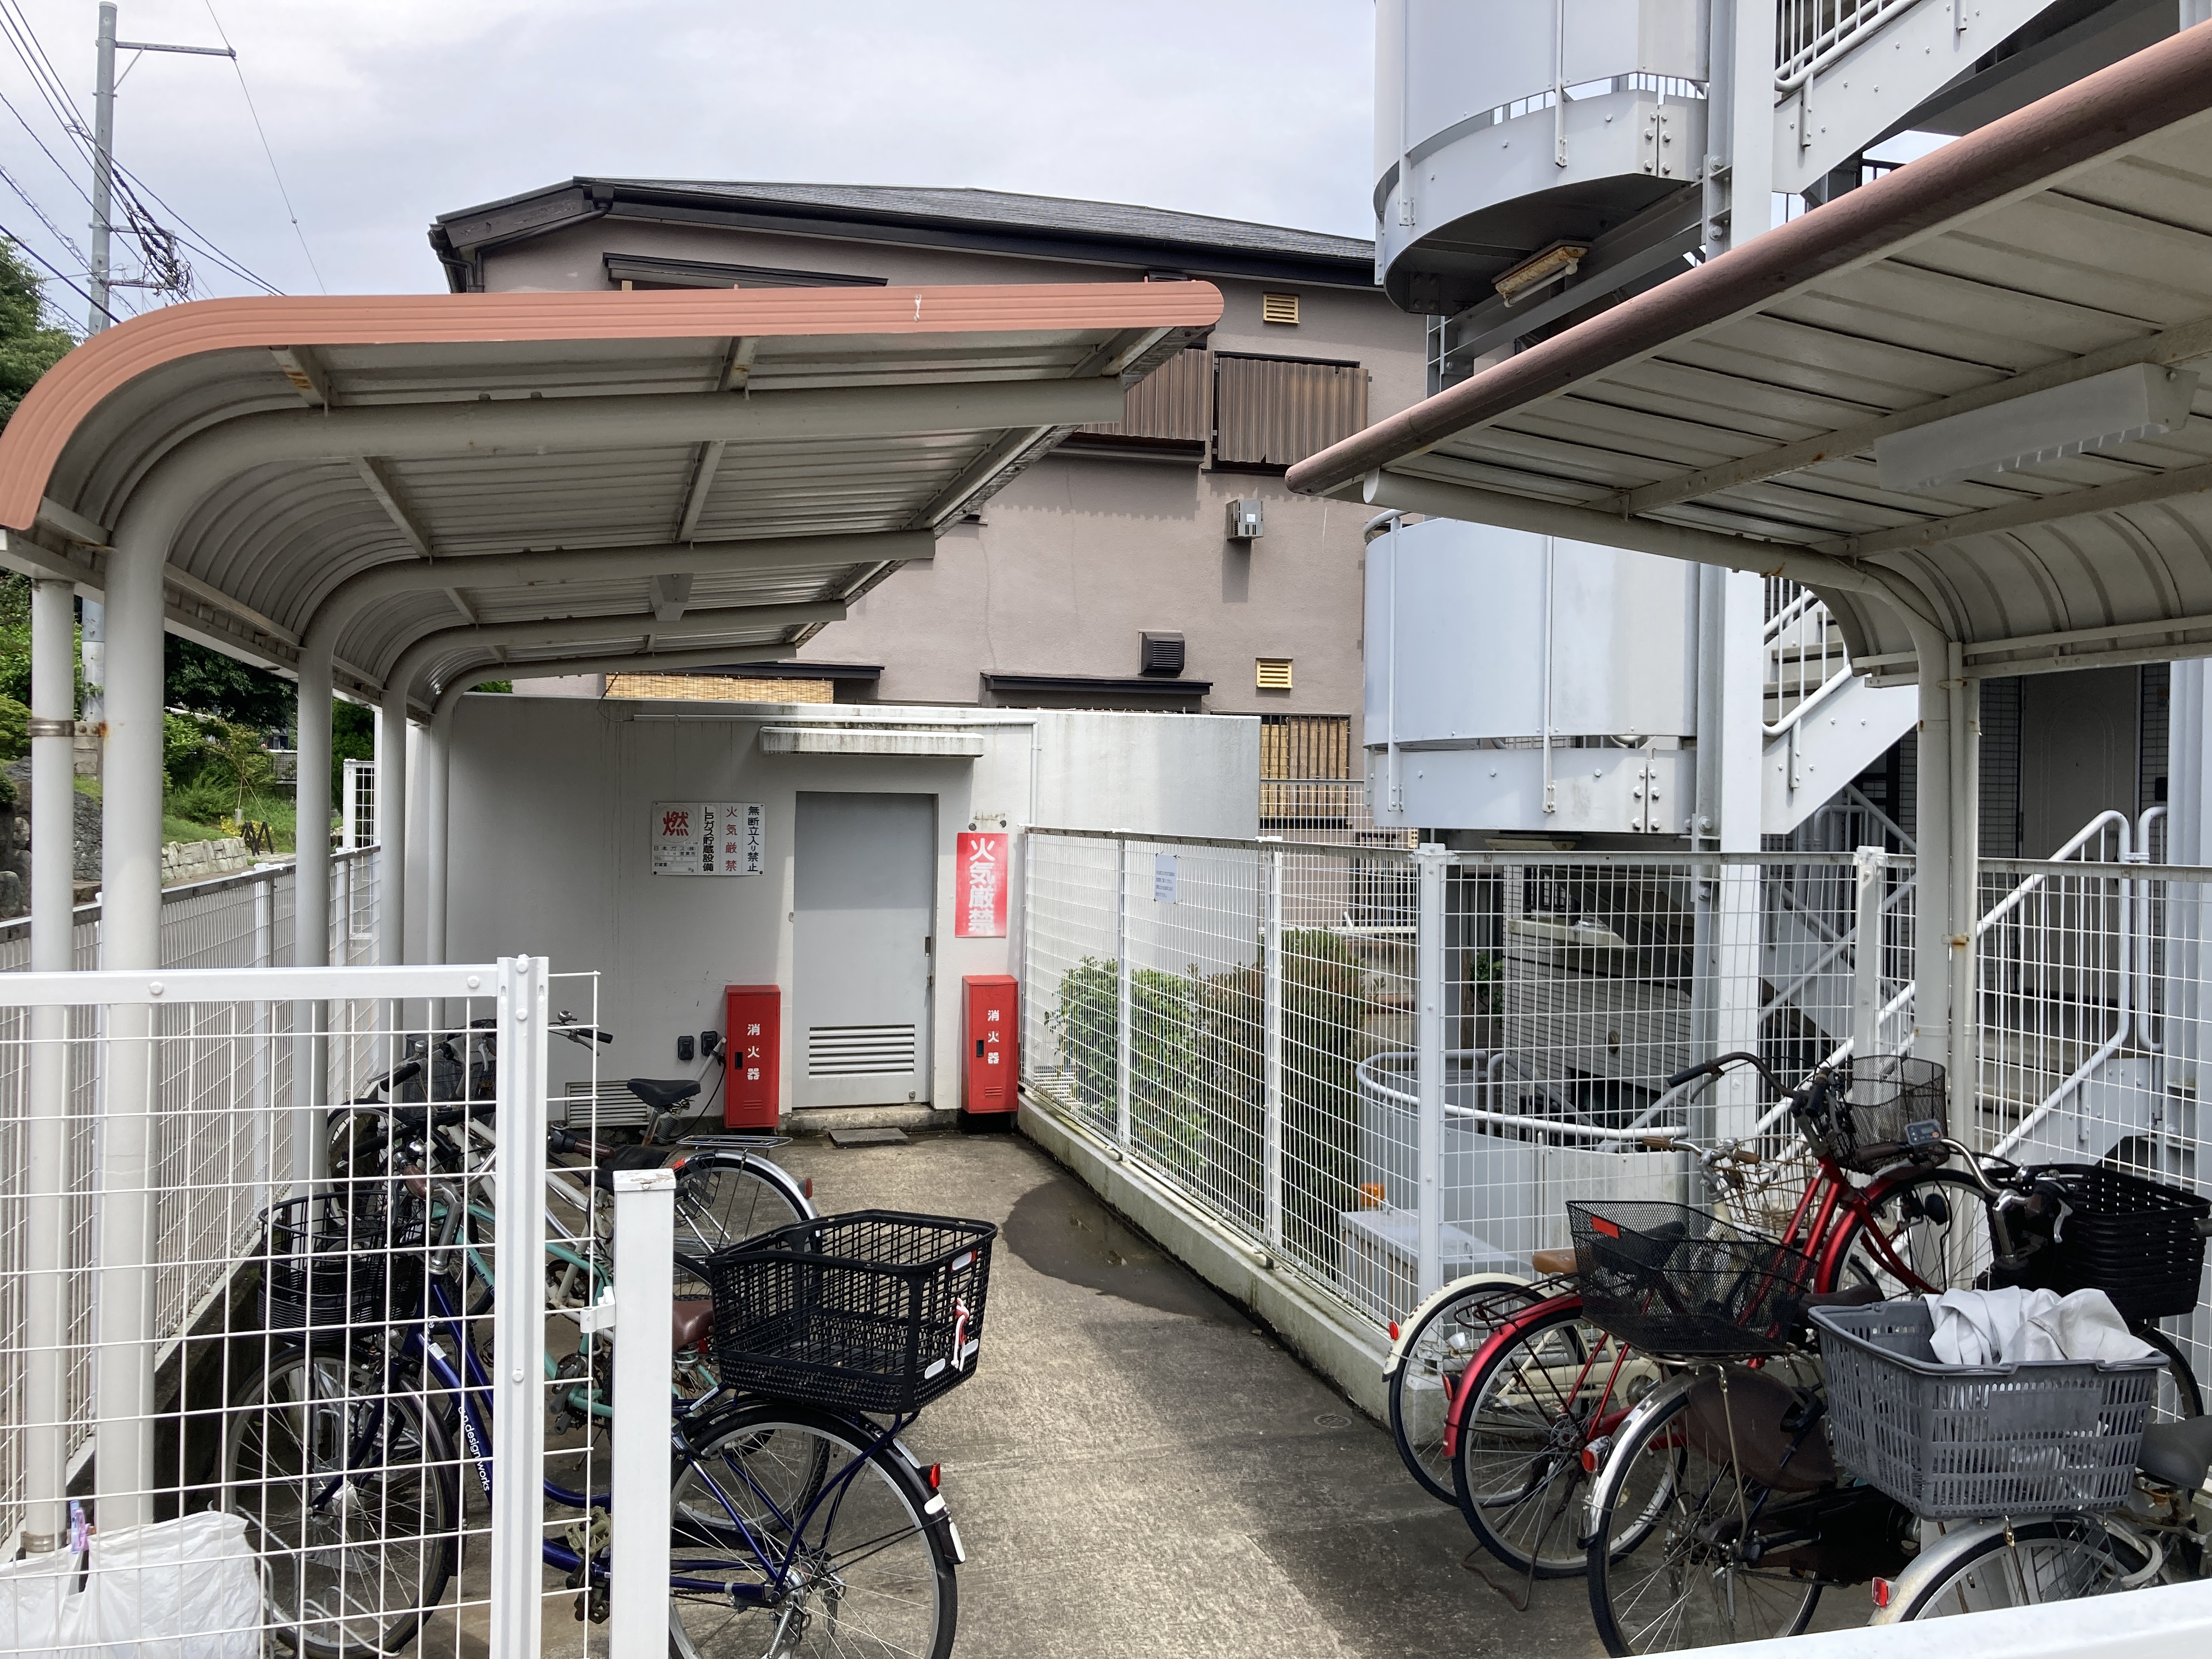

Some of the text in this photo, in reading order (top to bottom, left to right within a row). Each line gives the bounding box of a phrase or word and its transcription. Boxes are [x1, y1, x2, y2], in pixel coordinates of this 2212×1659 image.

[662, 810, 689, 837] 燃
[702, 806, 715, 872] LPガス貯蔵設備
[725, 806, 738, 872] 火気厳禁
[747, 806, 760, 872] 無断立入り禁止
[968, 837, 995, 934] 火気厳禁
[747, 1023, 760, 1080] 消火器
[987, 1009, 1000, 1065] 消火器
[477, 1460, 490, 1492] works
